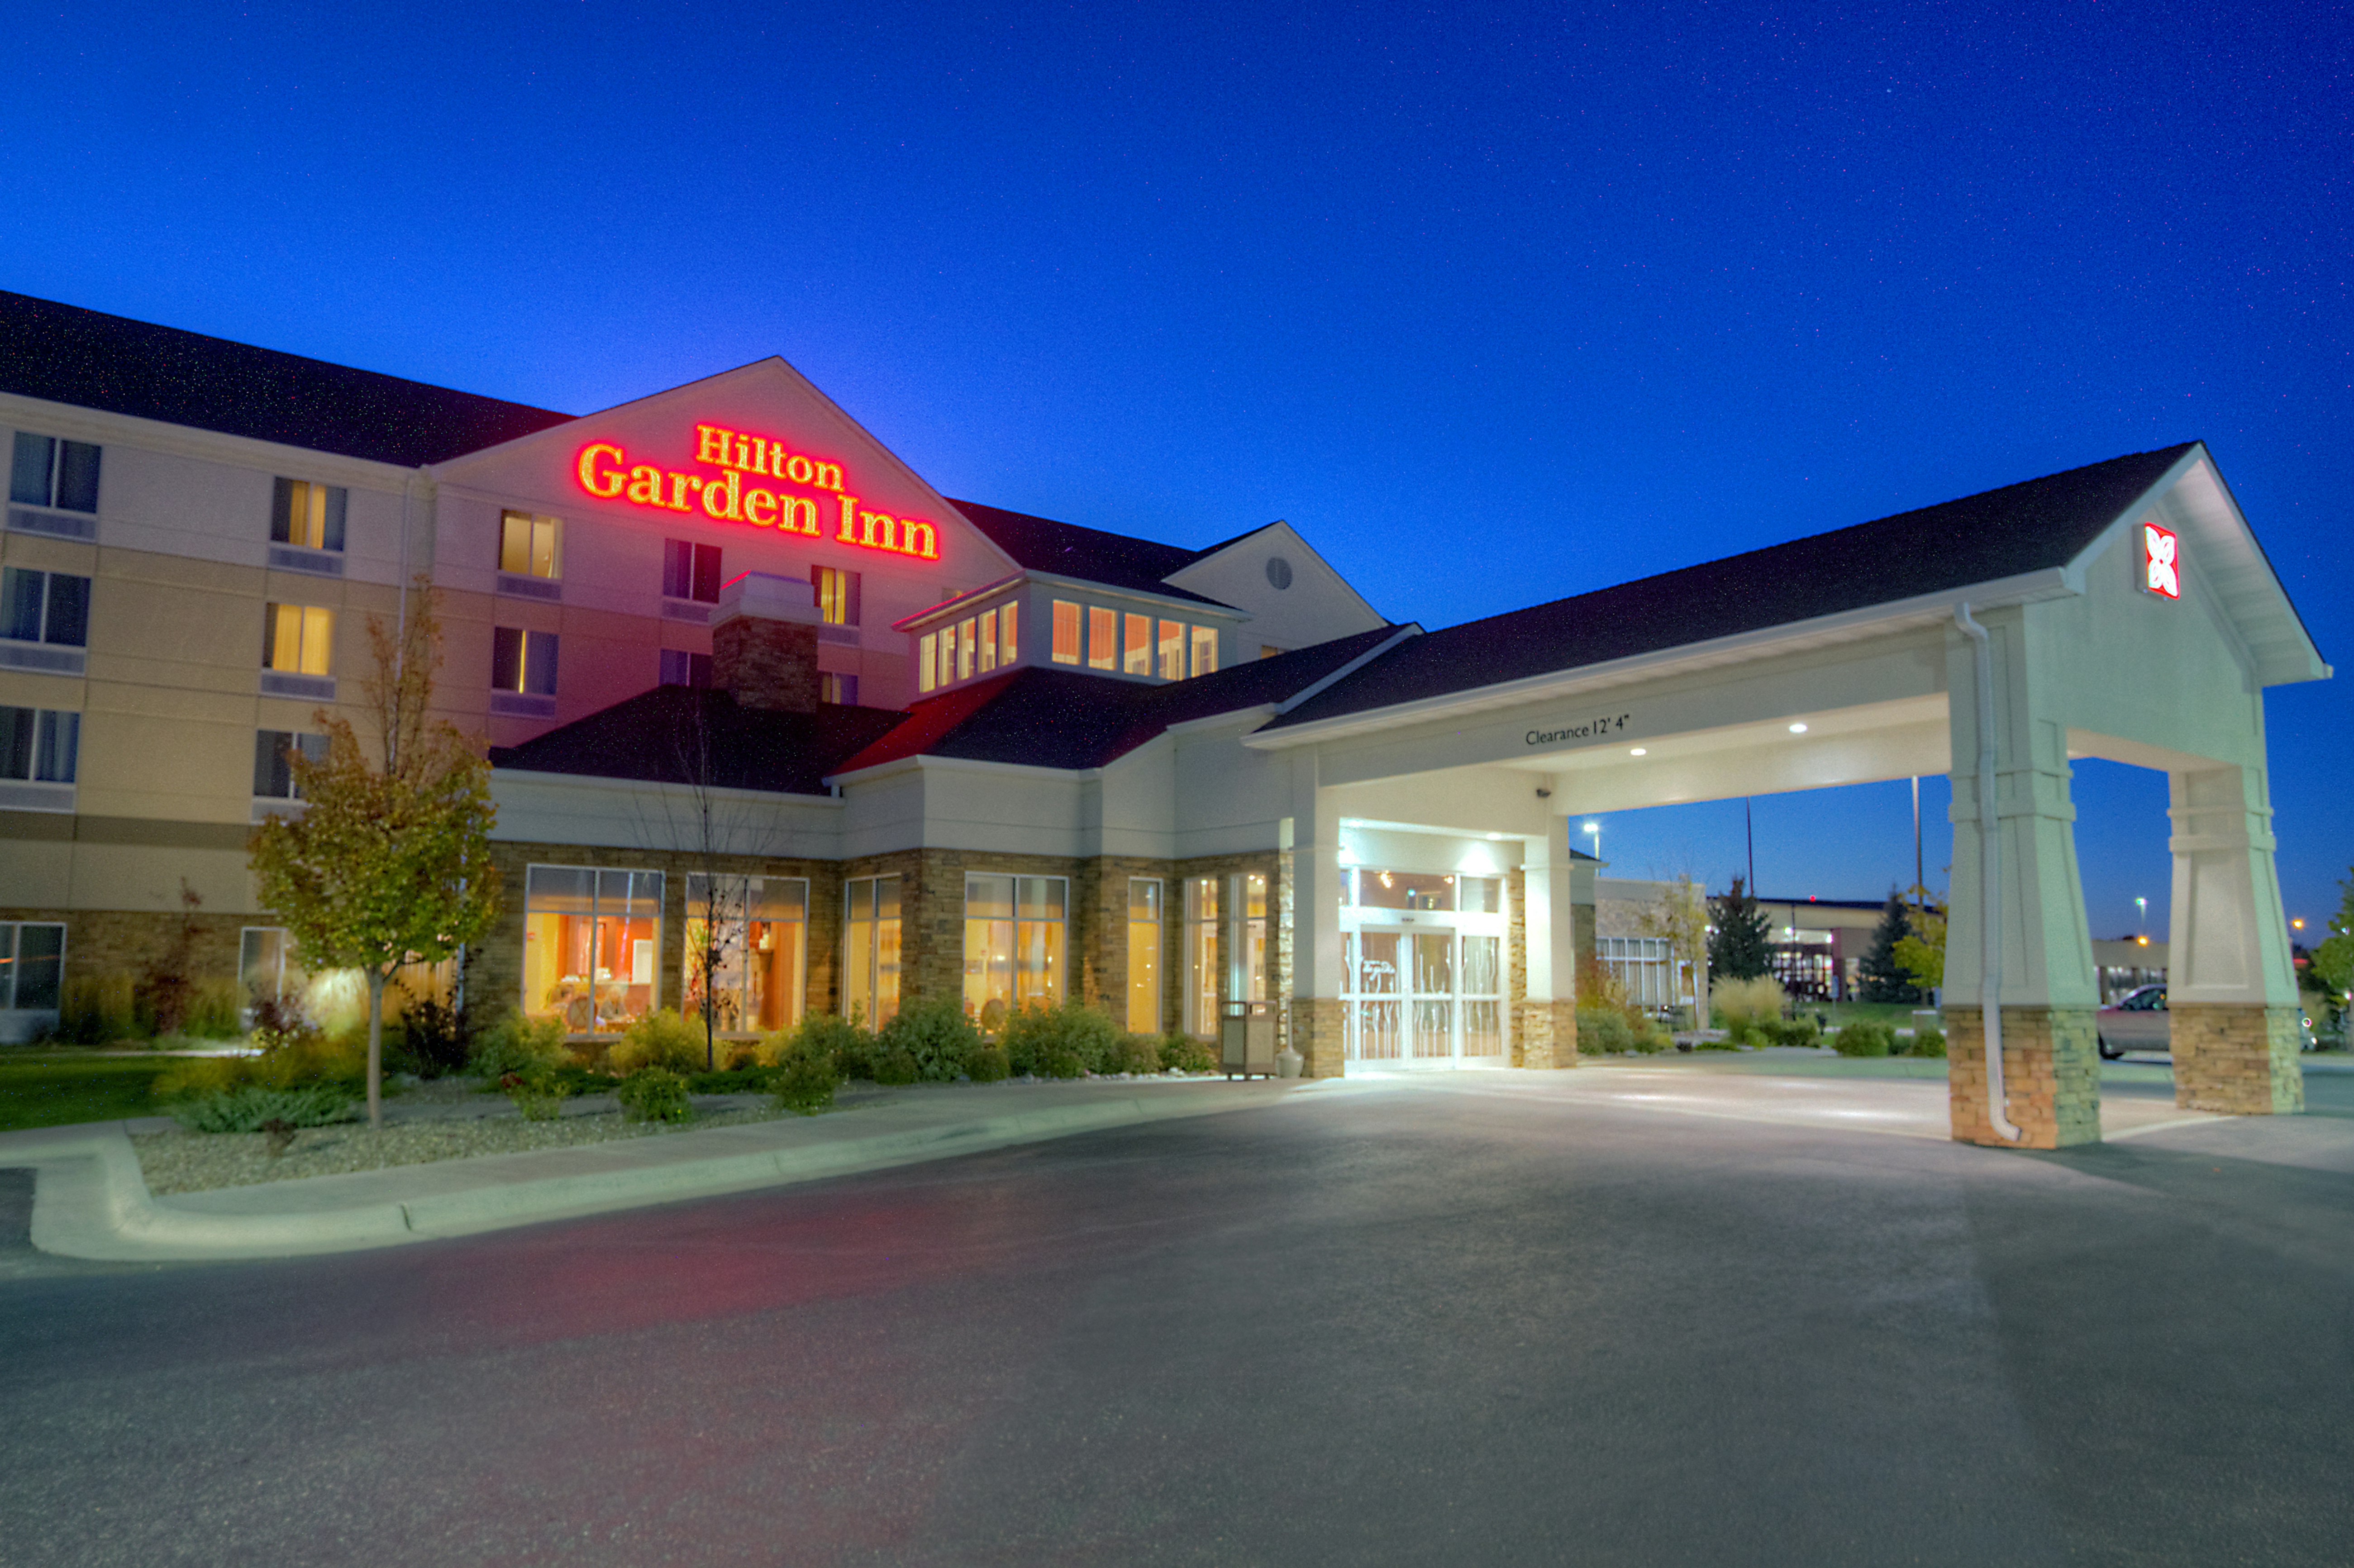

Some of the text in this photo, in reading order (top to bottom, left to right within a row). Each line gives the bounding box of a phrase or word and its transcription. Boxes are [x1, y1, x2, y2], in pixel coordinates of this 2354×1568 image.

[696, 424, 846, 493] Hilton
[577, 443, 940, 560] Garden Inn
[1525, 726, 1589, 745] Clearance
